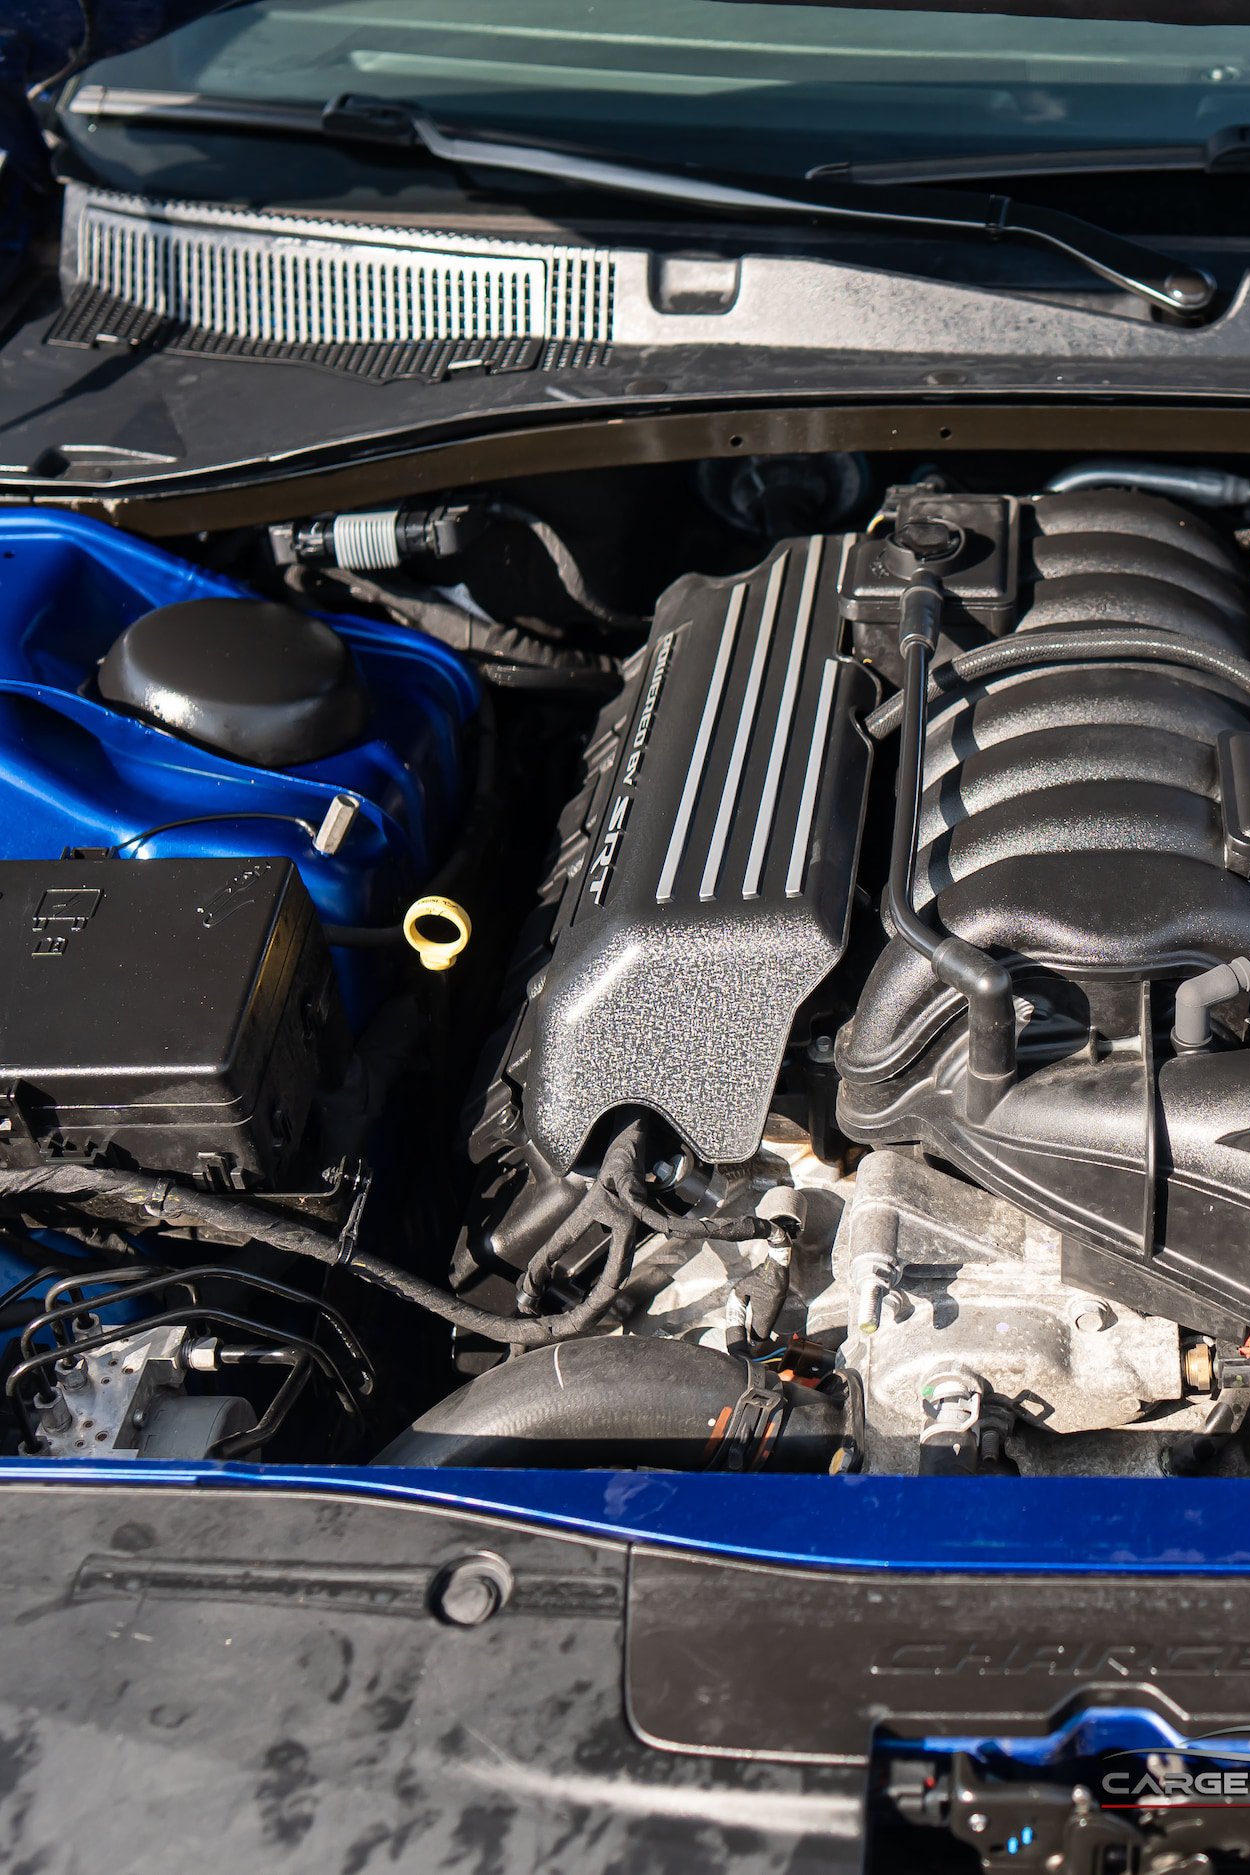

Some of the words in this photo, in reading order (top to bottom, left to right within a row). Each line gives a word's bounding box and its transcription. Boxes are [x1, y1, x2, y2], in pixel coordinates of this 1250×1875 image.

[633, 631, 676, 749] POWERED
[623, 750, 643, 787] BY
[590, 795, 632, 906] SRT
